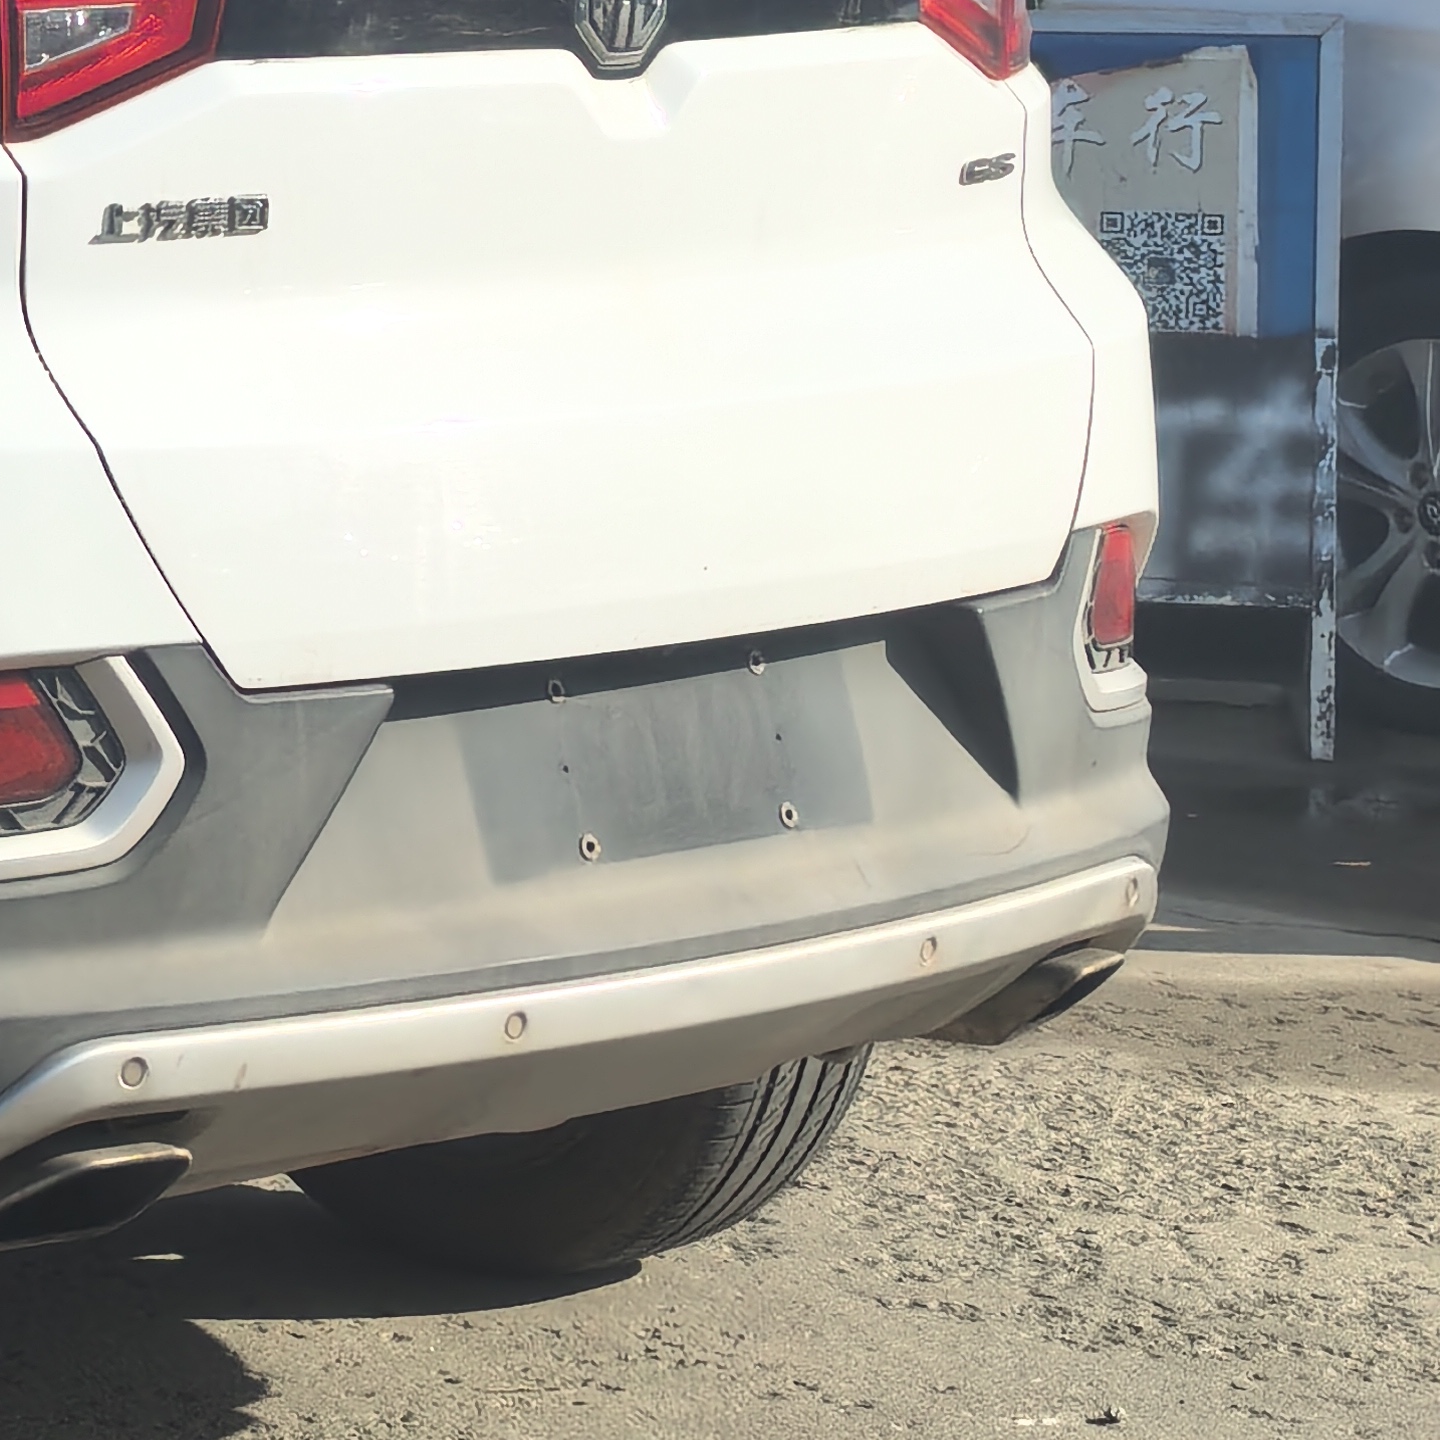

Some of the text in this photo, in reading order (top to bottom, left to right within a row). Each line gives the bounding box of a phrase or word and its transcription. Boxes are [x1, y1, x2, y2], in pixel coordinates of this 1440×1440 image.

[1050, 79, 1223, 175] 车行
[88, 193, 270, 245] 上汽集团
